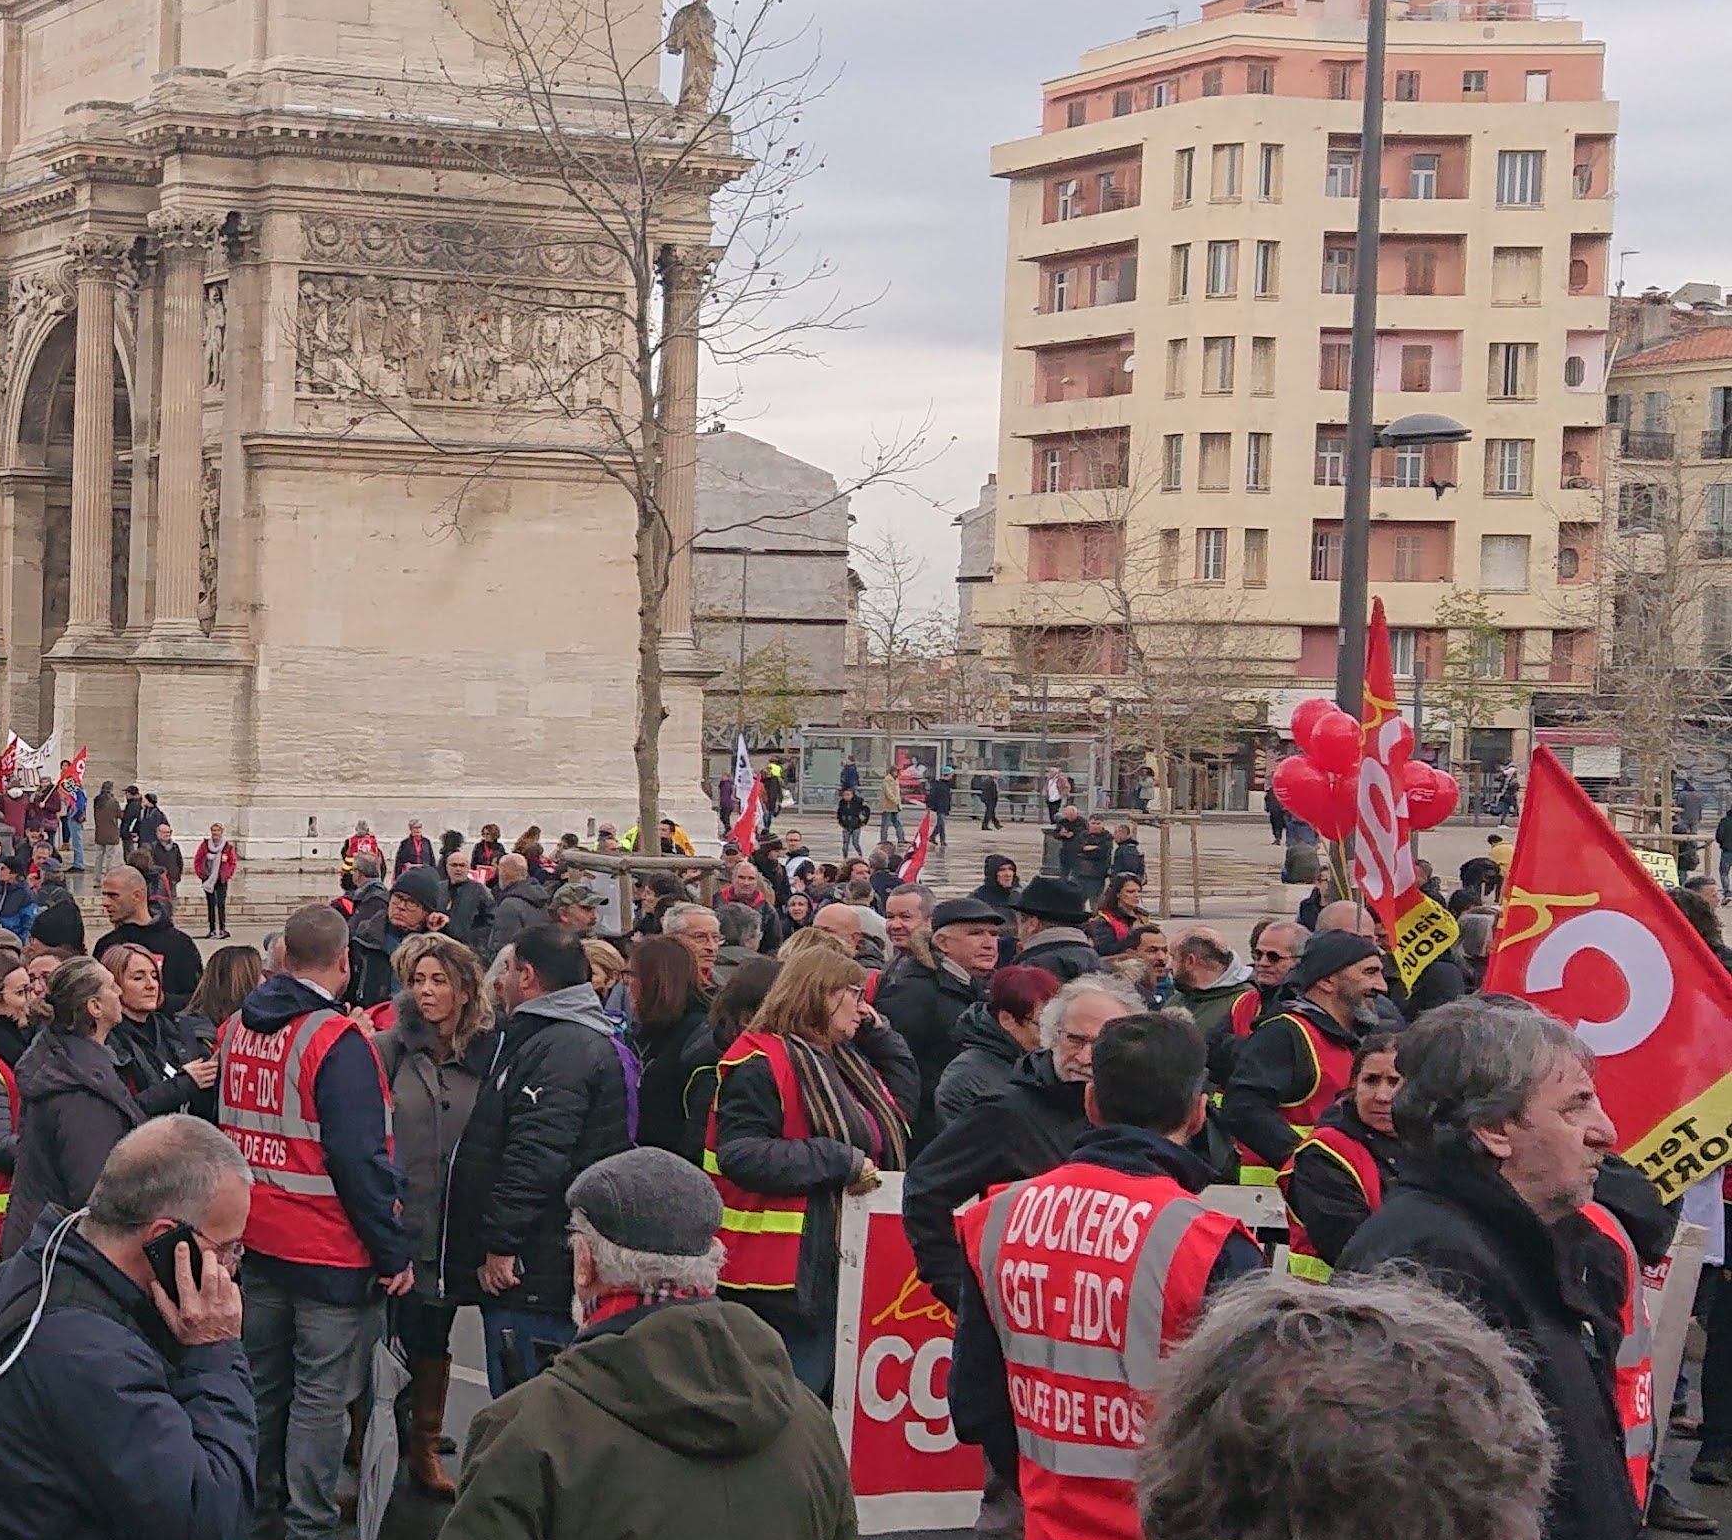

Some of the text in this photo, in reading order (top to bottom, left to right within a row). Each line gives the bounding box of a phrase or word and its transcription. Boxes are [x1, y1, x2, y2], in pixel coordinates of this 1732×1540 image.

[256, 1067, 279, 1111] IDC
[244, 1133, 262, 1162] DE
[261, 1137, 287, 1167] FOS
[1006, 1185, 1153, 1263] DOCKERS
[1001, 1258, 1049, 1330] CGT
[1070, 1270, 1124, 1346] IDC
[858, 1334, 961, 1453] cg
[1054, 1389, 1086, 1436] DE
[1093, 1396, 1146, 1445] FOS
